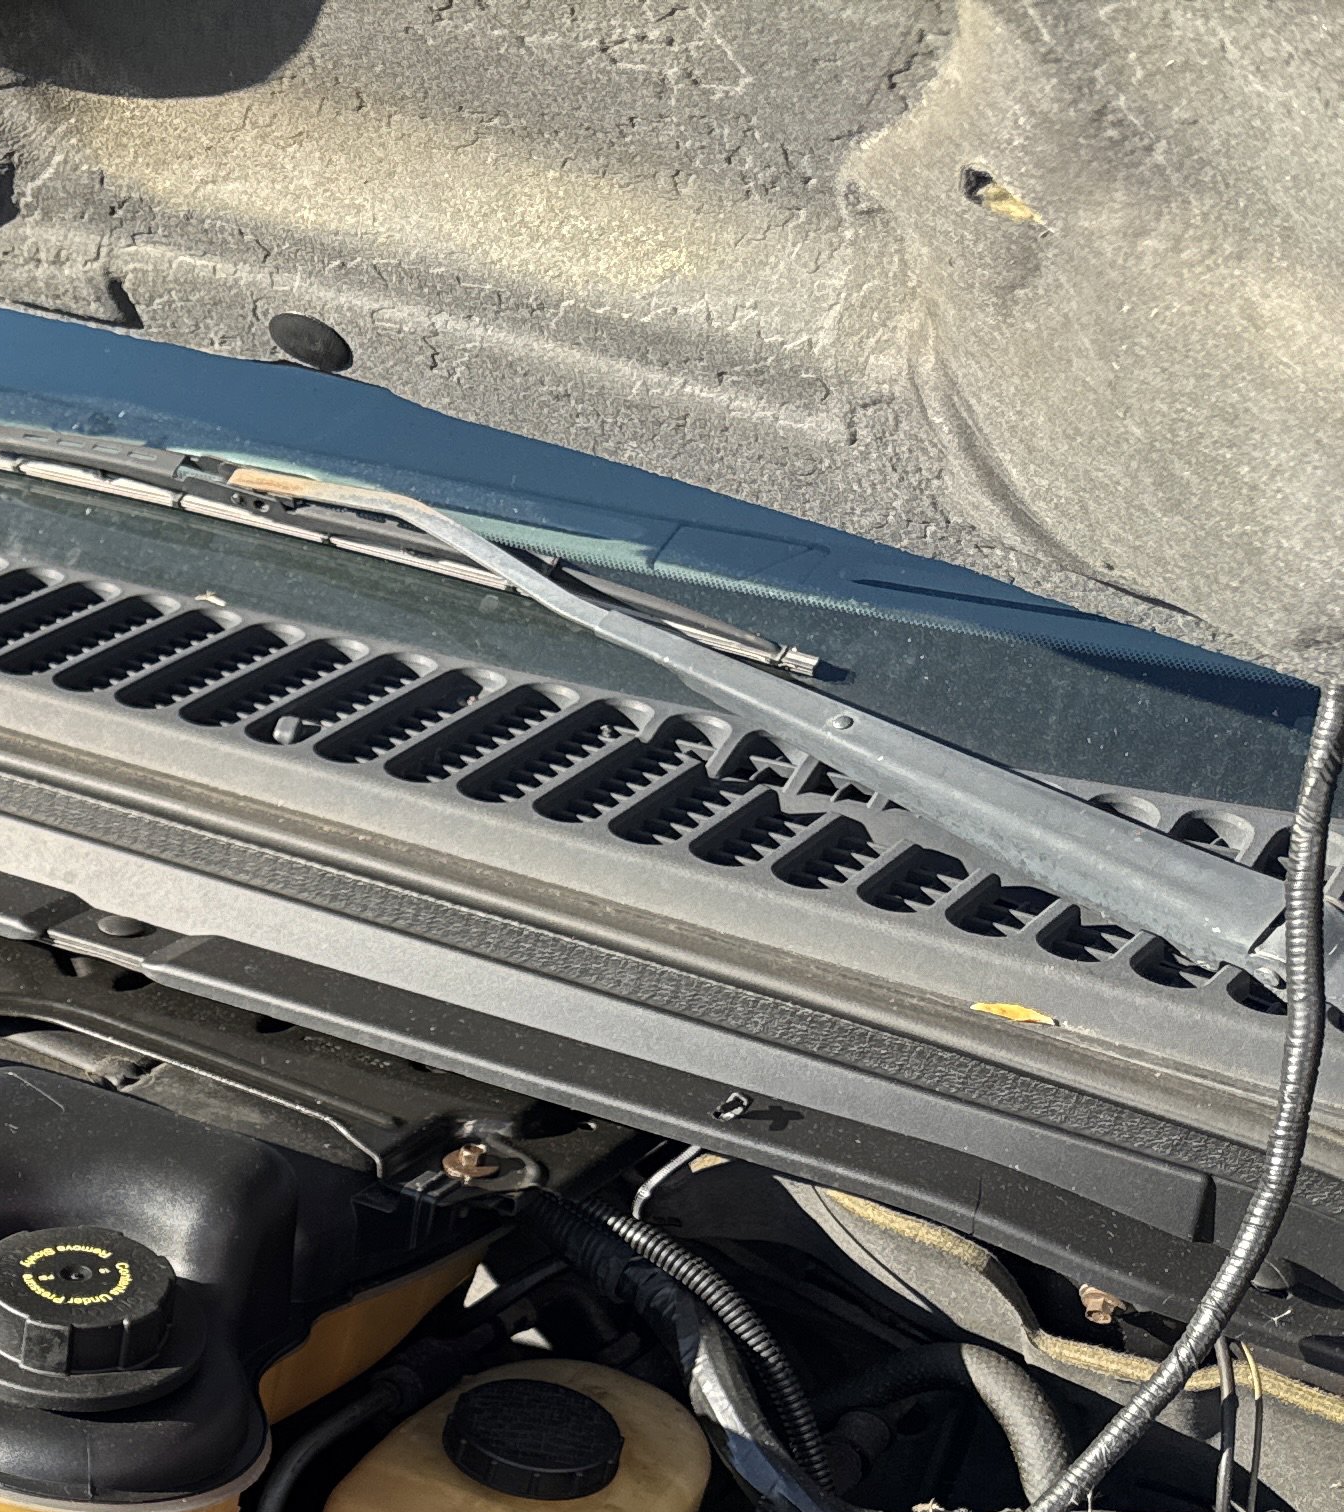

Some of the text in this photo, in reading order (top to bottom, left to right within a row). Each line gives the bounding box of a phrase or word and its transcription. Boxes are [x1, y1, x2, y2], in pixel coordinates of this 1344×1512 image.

[20, 1245, 112, 1268] Remove Slowly
[22, 1262, 134, 1306] Contents Under Pressure
